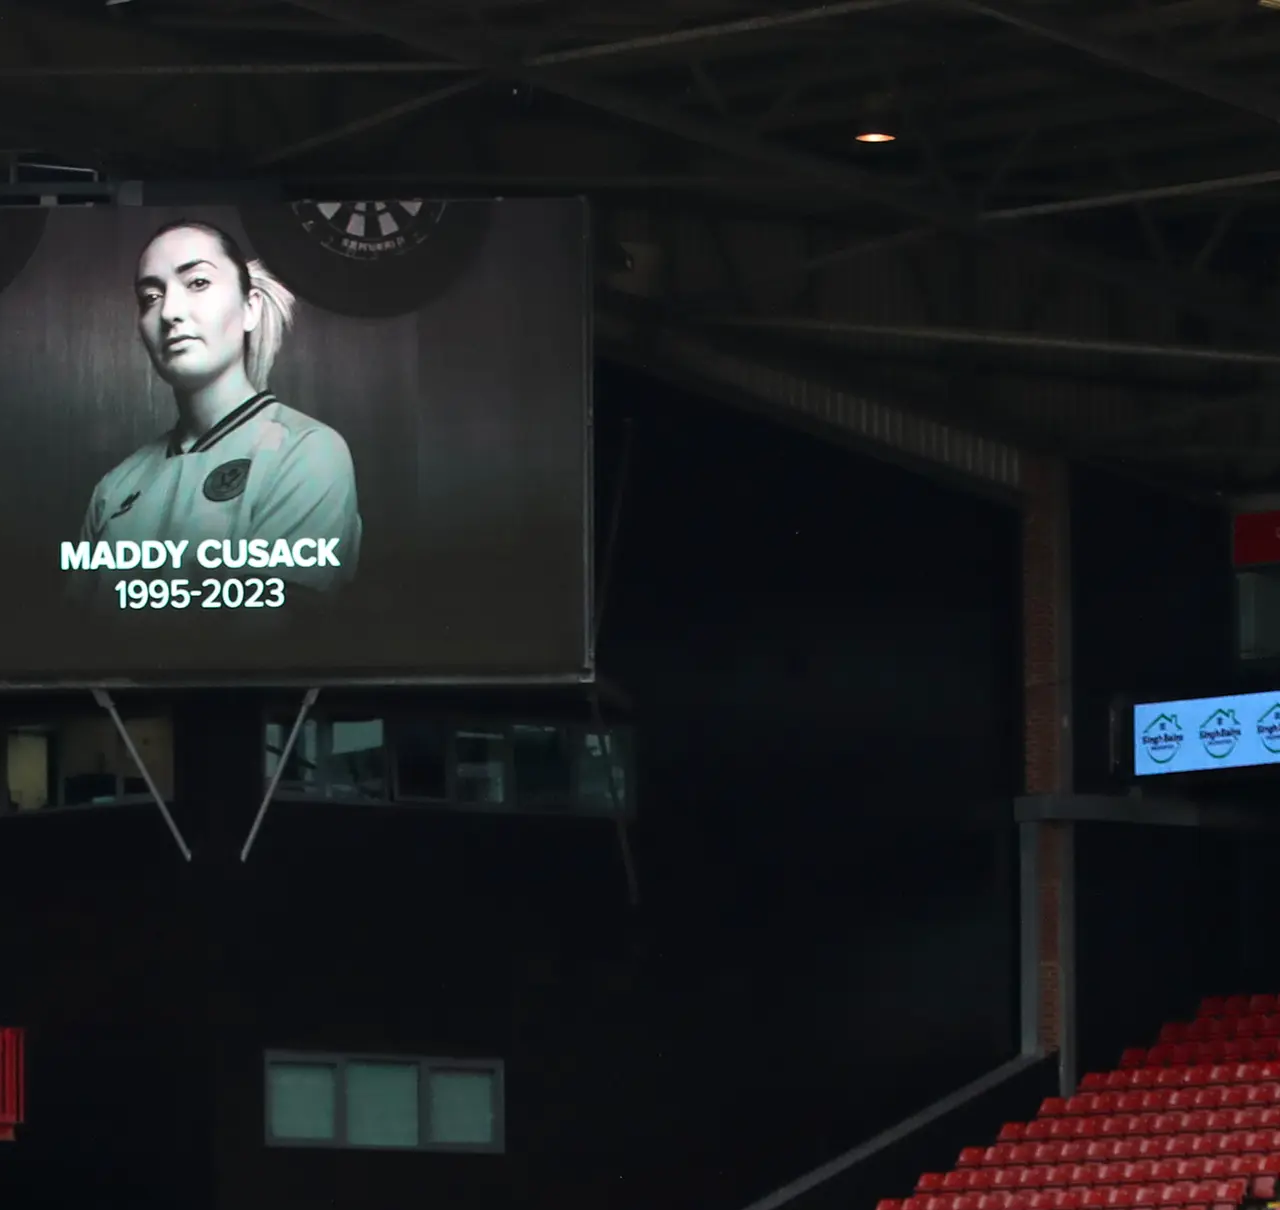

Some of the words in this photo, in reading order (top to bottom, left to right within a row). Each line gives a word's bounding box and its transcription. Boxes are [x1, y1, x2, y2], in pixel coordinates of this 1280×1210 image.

[60, 540, 188, 570] MADDY
[196, 537, 340, 568] CUSACK
[114, 577, 286, 609] 1995-2023
